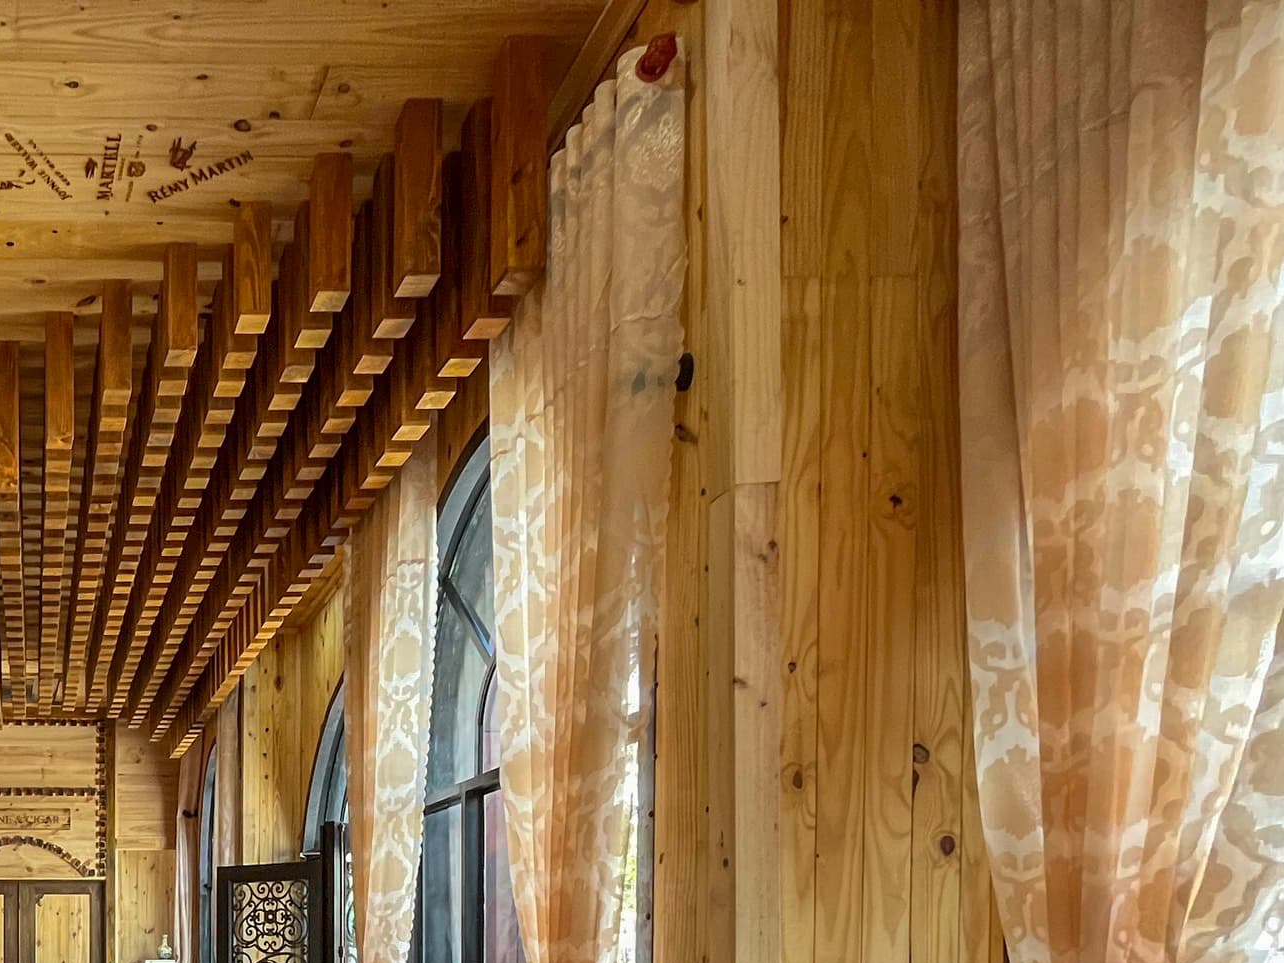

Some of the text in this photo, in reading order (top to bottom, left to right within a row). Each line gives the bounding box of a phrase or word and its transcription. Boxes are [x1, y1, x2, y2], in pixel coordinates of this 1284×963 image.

[96, 133, 121, 201] MARTELL
[189, 150, 254, 185] MARTIN
[25, 815, 60, 825] CIGAR
